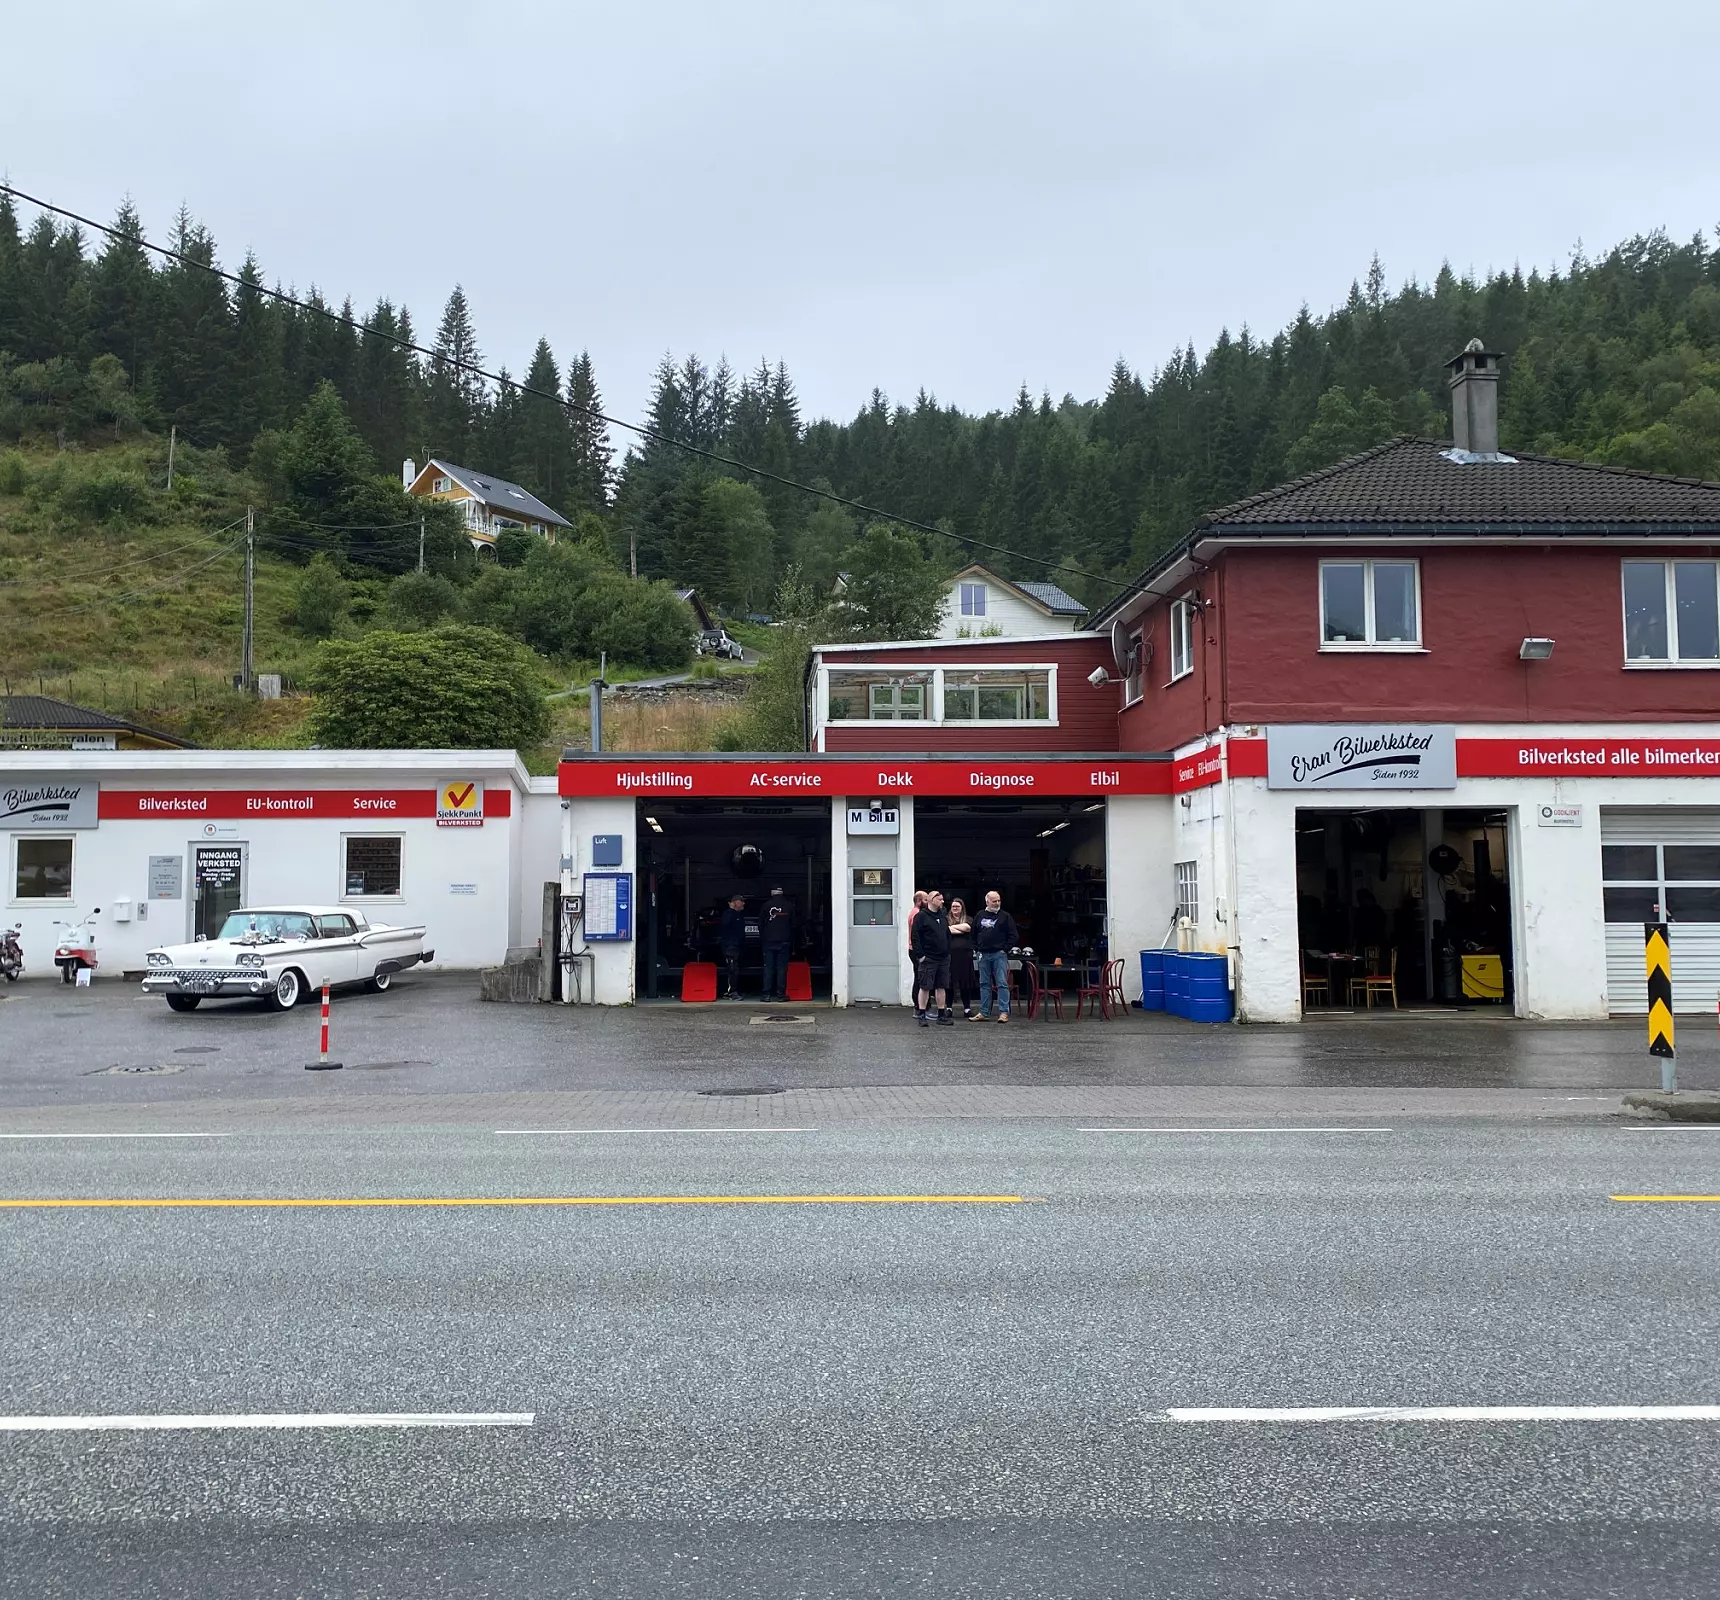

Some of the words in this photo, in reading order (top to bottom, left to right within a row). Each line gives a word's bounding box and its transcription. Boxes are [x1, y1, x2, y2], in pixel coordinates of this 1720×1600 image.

[1291, 751, 1331, 782] Eran
[1333, 732, 1434, 765] Bilverksted
[1518, 748, 1605, 765] Bilverksted
[1610, 748, 1640, 765] alle
[1645, 748, 1720, 765] bilmerker
[1179, 765, 1194, 782] Service
[1197, 753, 1222, 776] EU-kontrol
[616, 772, 693, 789] Hjulstilling
[750, 773, 822, 786] AC-service
[878, 773, 913, 786] Dekk
[970, 773, 1034, 789] Diagnose
[1091, 772, 1120, 786] Elbil
[1371, 769, 1397, 780] Siden
[1398, 769, 1419, 779] 1932
[3, 786, 81, 811] Bilverksted
[138, 798, 207, 810] Bilverksted
[246, 797, 313, 810] EU-kontroll
[353, 798, 397, 809] Service
[200, 851, 239, 859] INNGANG
[197, 860, 241, 868] VERKSTED
